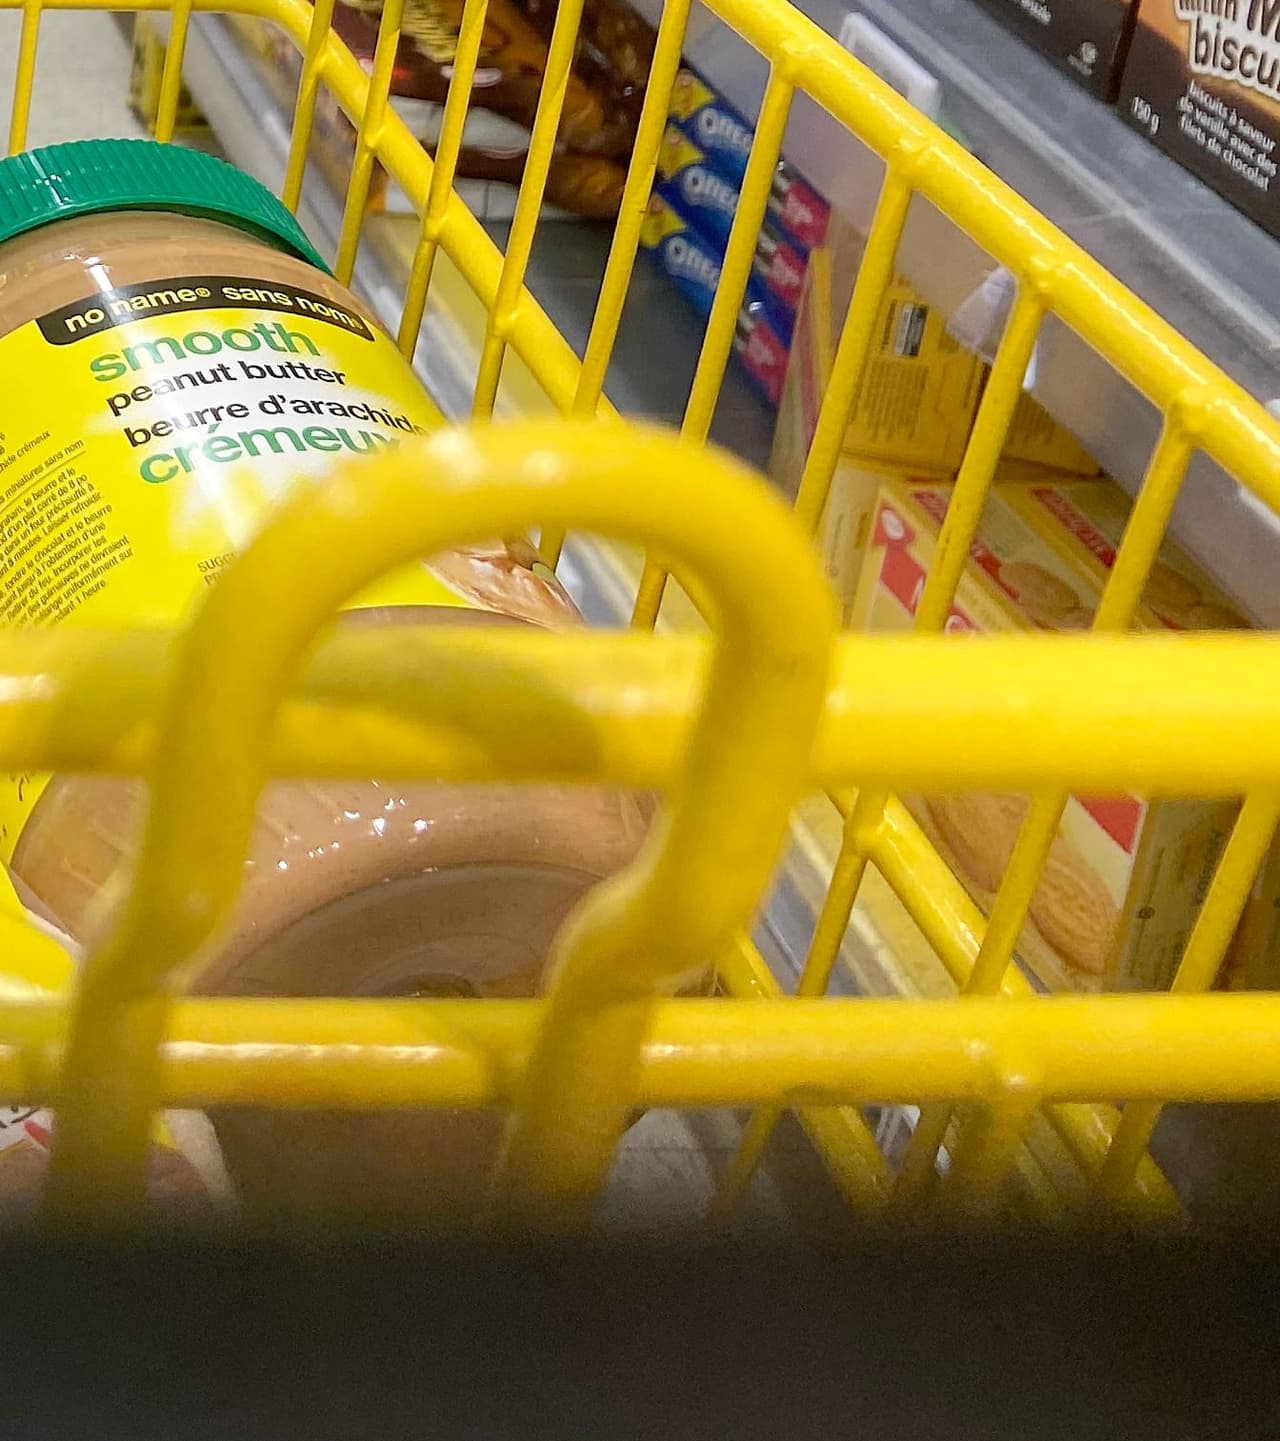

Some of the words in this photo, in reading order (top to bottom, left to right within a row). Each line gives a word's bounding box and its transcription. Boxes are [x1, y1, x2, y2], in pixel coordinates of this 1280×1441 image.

[65, 305, 106, 335] no
[221, 284, 294, 307] sans
[89, 322, 322, 383] smooth
[105, 360, 247, 417] peanut
[241, 358, 349, 388] butter
[125, 405, 251, 449] beurre
